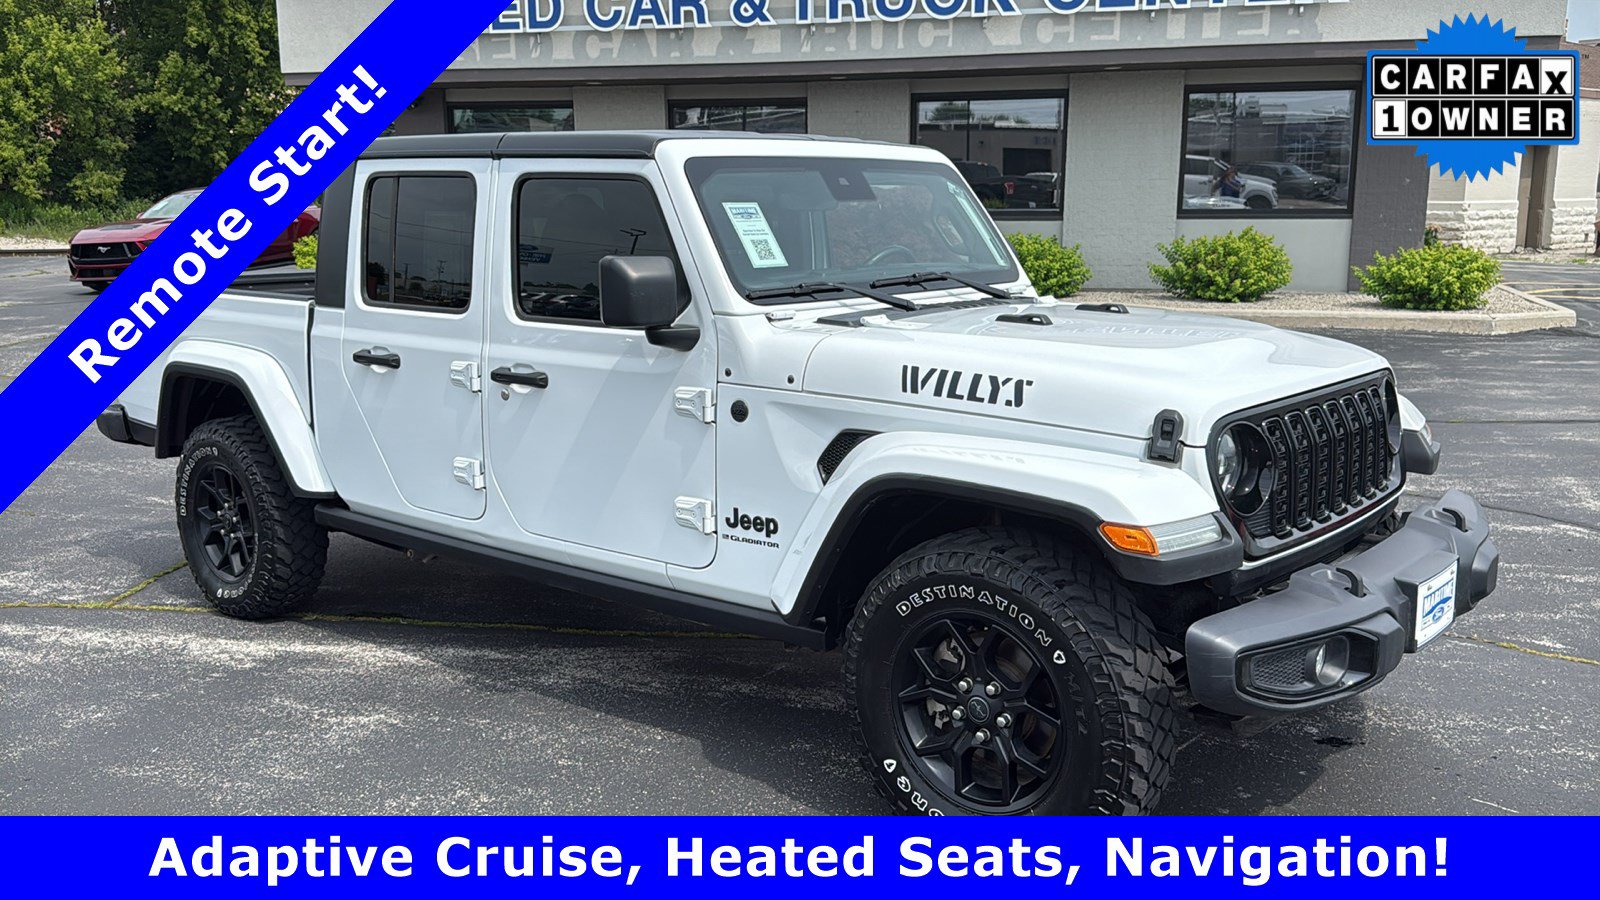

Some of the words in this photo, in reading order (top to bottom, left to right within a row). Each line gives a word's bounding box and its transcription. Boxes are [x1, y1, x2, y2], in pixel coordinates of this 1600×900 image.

[583, 0, 712, 32] CAR
[729, 0, 777, 27] &
[902, 365, 1033, 408] WILLYS
[725, 507, 778, 538] Jeep
[731, 535, 779, 548] GLADIATOR
[896, 585, 1052, 647] DESTINATION
